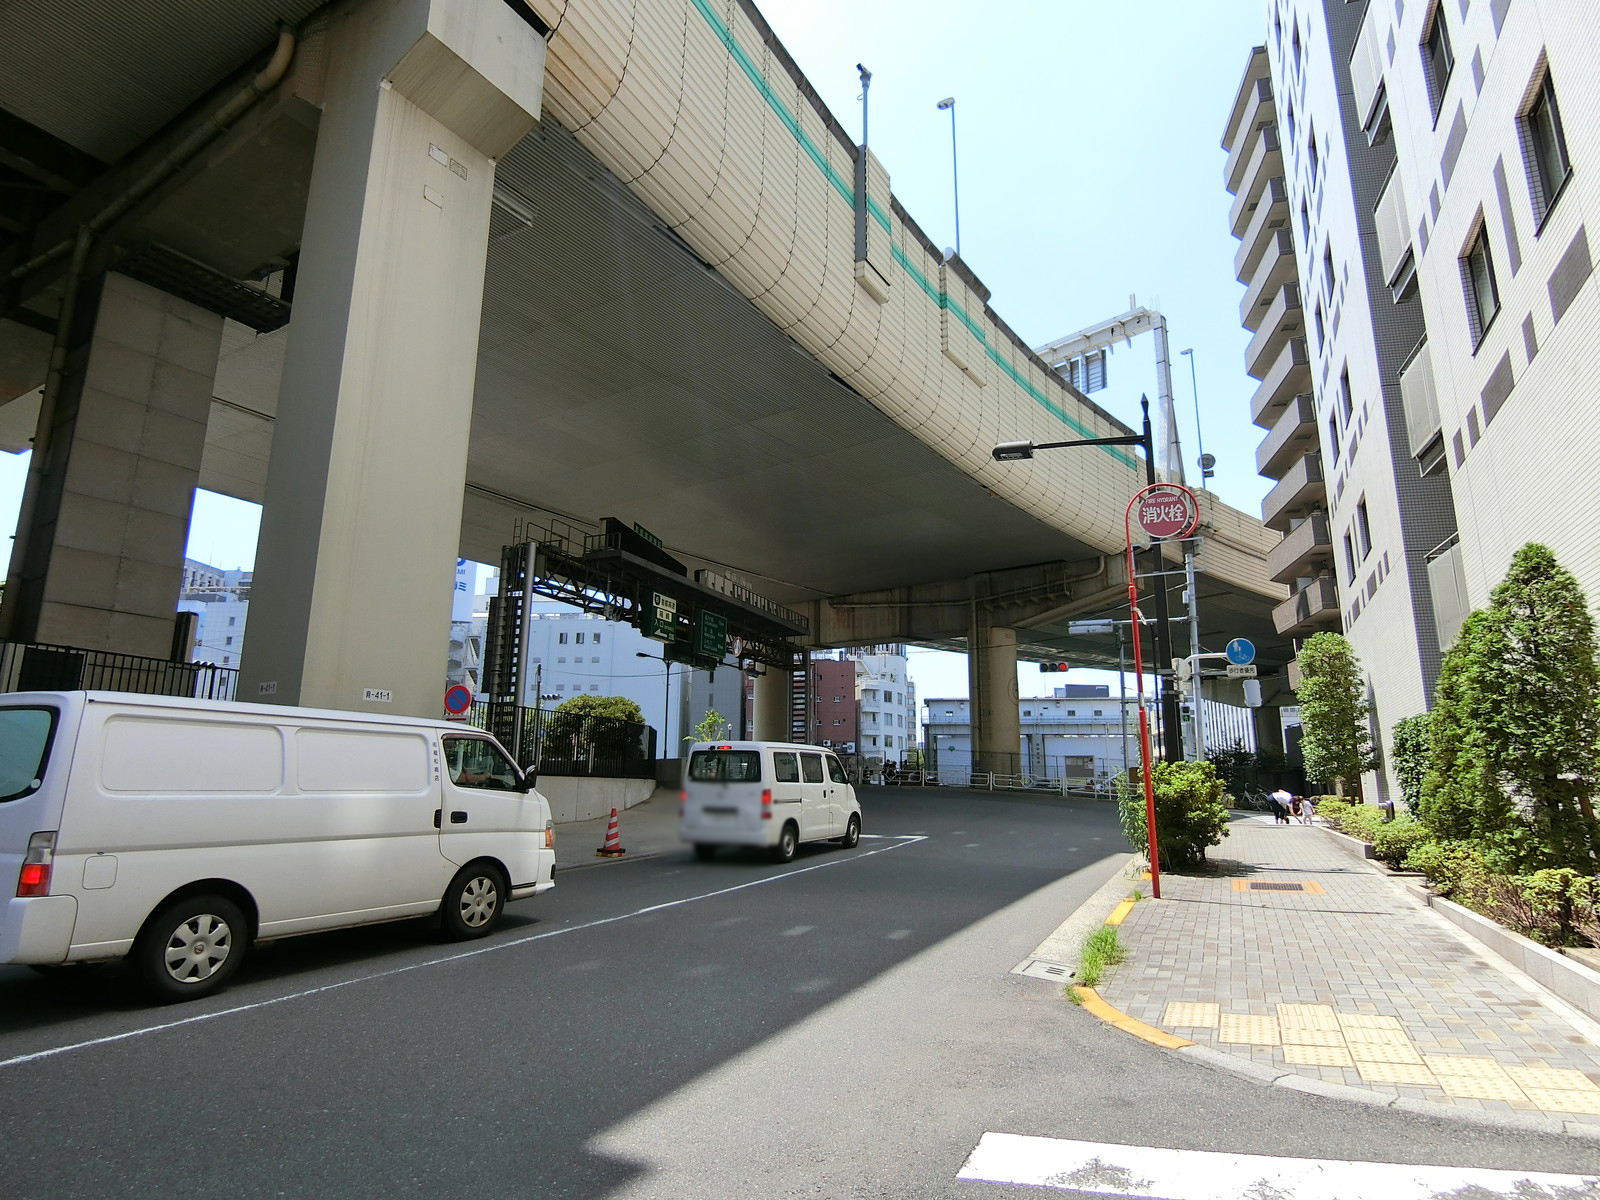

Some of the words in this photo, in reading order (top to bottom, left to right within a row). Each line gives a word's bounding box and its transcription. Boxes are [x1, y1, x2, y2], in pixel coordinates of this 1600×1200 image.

[1142, 503, 1184, 524] 消火栓
[653, 618, 664, 628] 入口
